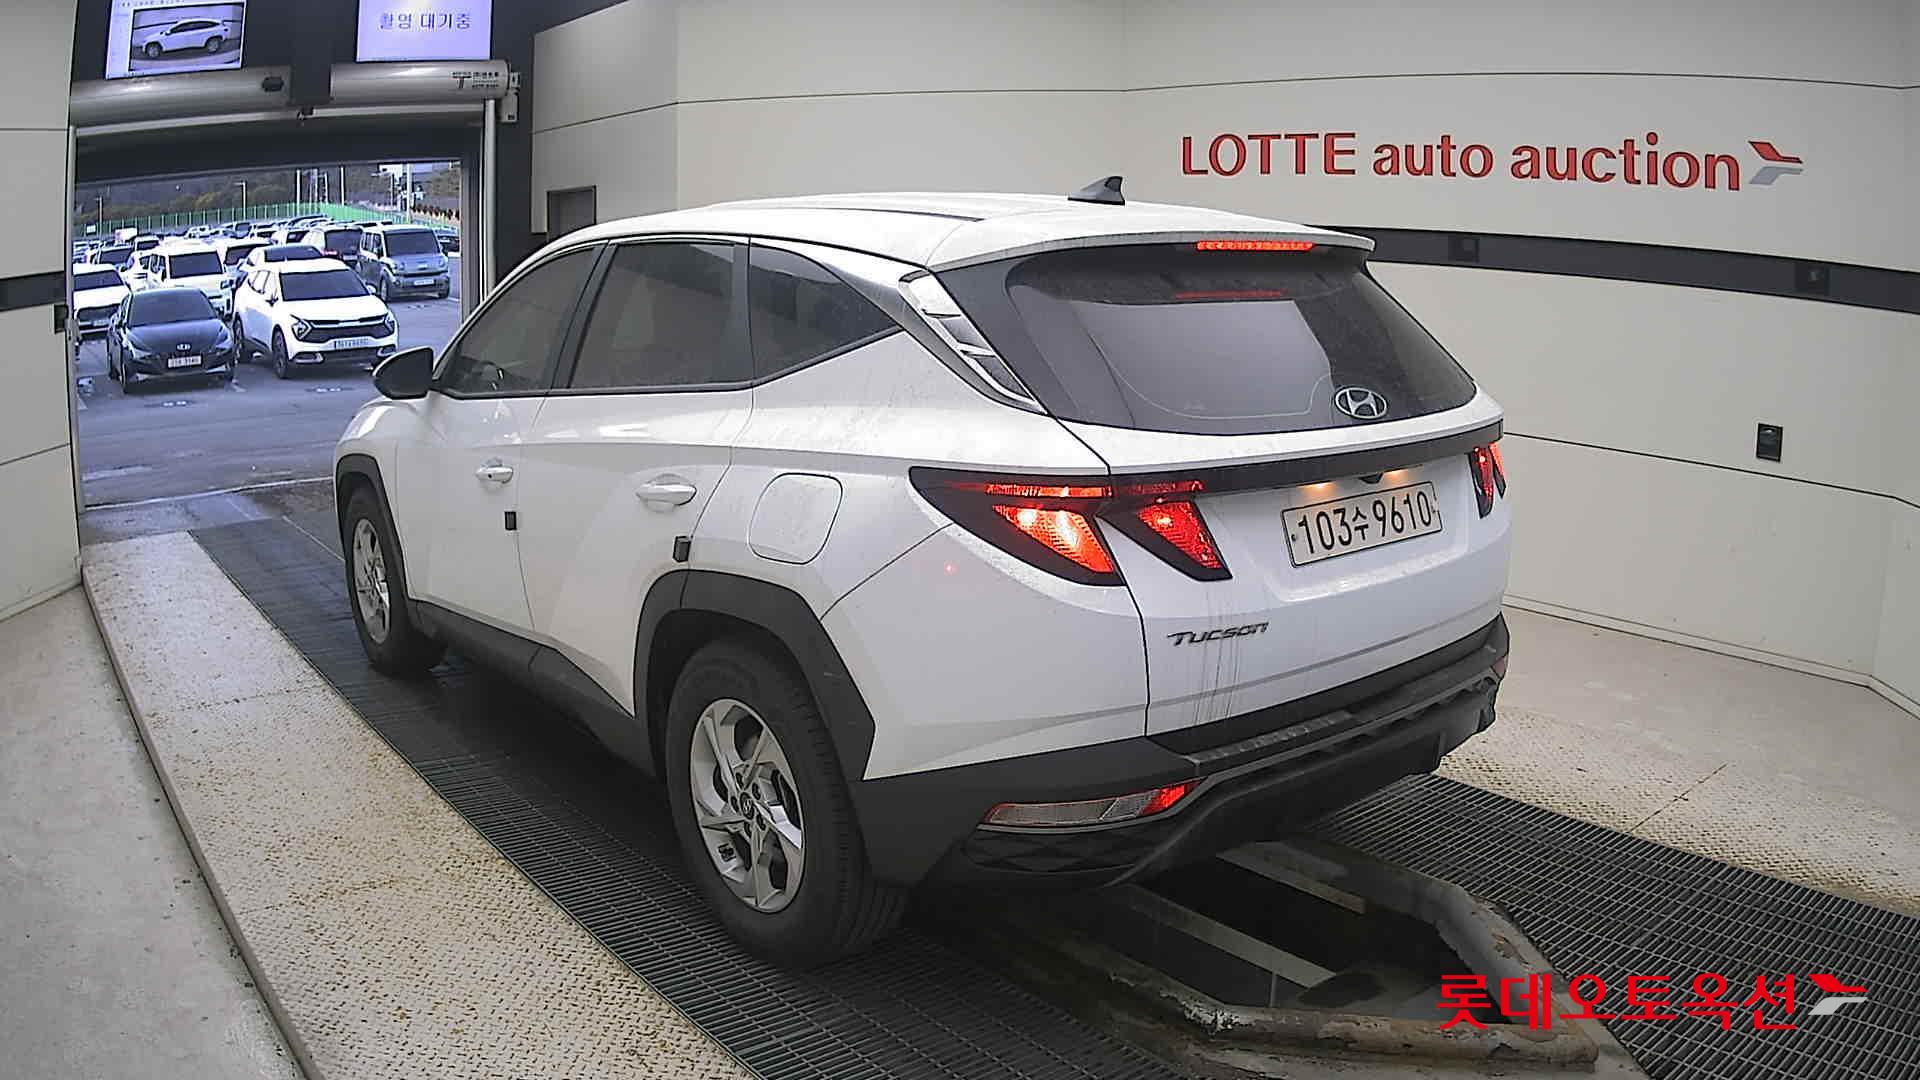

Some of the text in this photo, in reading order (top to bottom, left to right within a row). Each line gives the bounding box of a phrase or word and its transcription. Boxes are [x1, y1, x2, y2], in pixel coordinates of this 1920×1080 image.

[1182, 132, 1741, 191] LOTTE auto auction
